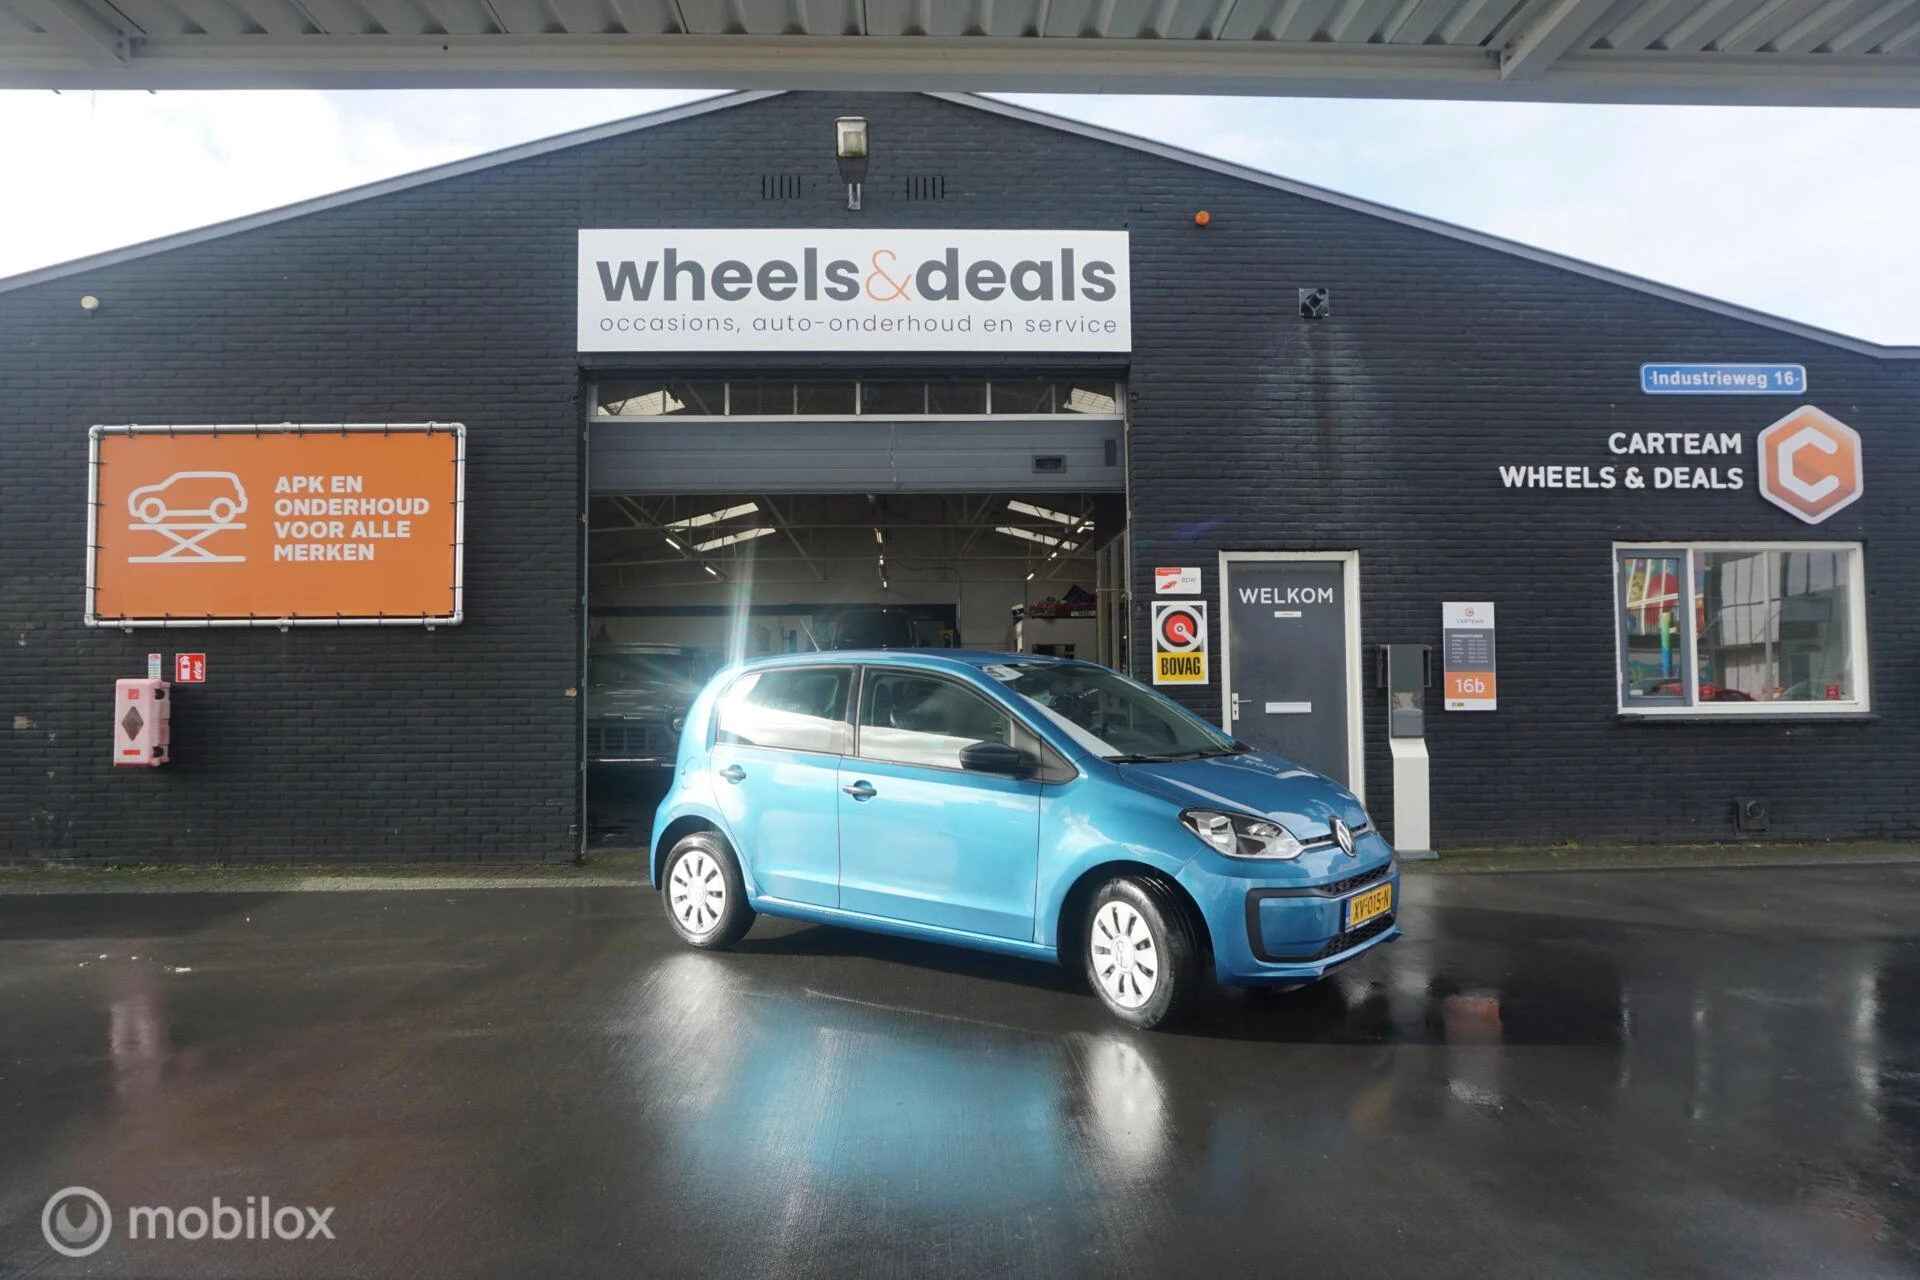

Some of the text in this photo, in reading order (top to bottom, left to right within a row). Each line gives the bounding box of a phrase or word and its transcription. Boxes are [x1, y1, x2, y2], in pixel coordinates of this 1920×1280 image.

[600, 314, 1117, 334] occasions, auto-onderhoud en service
[1652, 370, 1795, 389] Industrieweg 16
[1608, 432, 1742, 455] CARTEAM
[274, 475, 363, 493] APK EN
[1499, 466, 1744, 490] WHEELS & DEALS
[274, 498, 430, 516] ONDERHOUD
[274, 520, 411, 539] VOOR ALLE
[273, 543, 375, 561] MERKEN
[1238, 587, 1334, 604] WELKOM
[1161, 657, 1201, 676] BOVAG
[1456, 678, 1486, 693] 16b
[1353, 888, 1390, 922] XV-015-N
